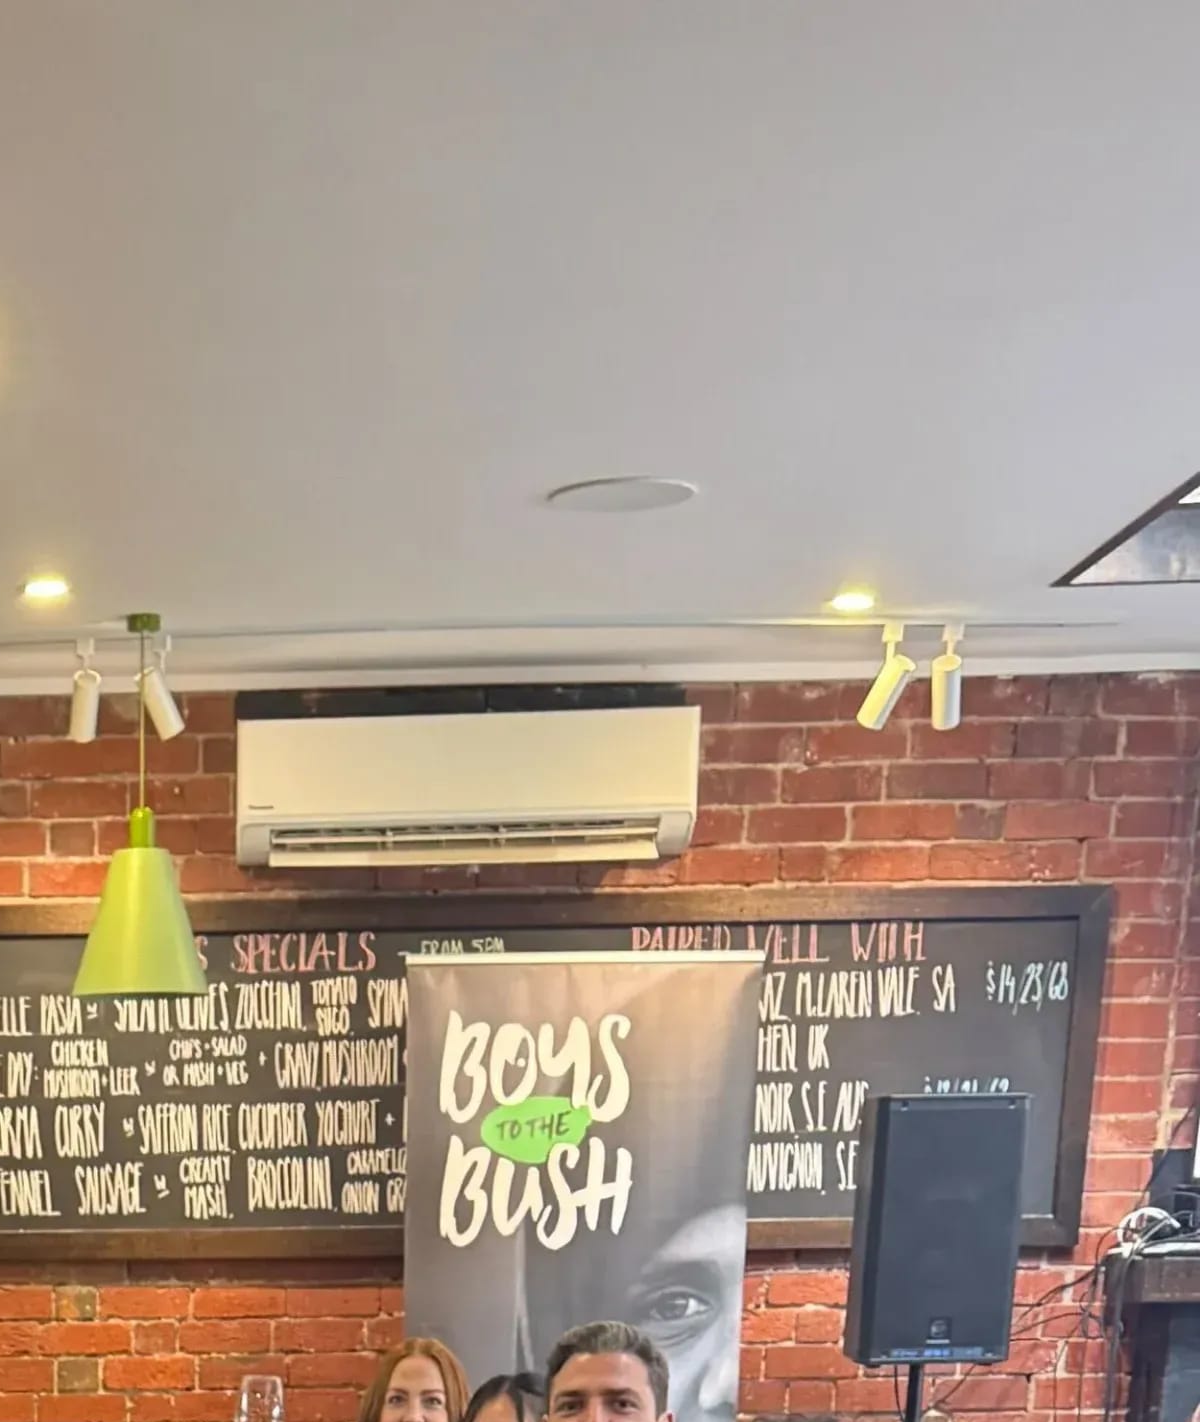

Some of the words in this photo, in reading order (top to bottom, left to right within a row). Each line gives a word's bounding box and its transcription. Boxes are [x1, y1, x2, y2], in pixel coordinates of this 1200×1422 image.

[231, 931, 376, 974] SPECIALS
[746, 924, 830, 964] WELL
[850, 920, 927, 963] WITH
[310, 975, 357, 1005] TOMATO
[931, 963, 957, 1013] SA
[40, 994, 83, 1036] PASTA
[51, 1038, 109, 1067] CHICKEN
[169, 1037, 202, 1062] CHIPS
[211, 1034, 248, 1058] SALAD
[322, 1034, 398, 1088] MUSHROOM
[440, 1010, 631, 1123] BOYS
[807, 1024, 830, 1072] UK
[43, 1068, 100, 1099] MUSHROOM
[109, 1066, 141, 1096] LEEK
[163, 1064, 181, 1086] OR
[183, 1061, 215, 1088] MASH
[225, 1060, 249, 1086] VEG
[54, 1101, 106, 1158] CURRY
[137, 1103, 198, 1155] SAFFRON
[238, 1101, 308, 1151] CUCUMBER
[315, 1098, 380, 1147] YOGHURT
[496, 1119, 522, 1141] TO
[526, 1111, 572, 1141] THE
[74, 1161, 147, 1217] SAUSAGE
[179, 1155, 232, 1184] CREAMY
[341, 1180, 380, 1215] ONION
[439, 1134, 633, 1251] BUSH
